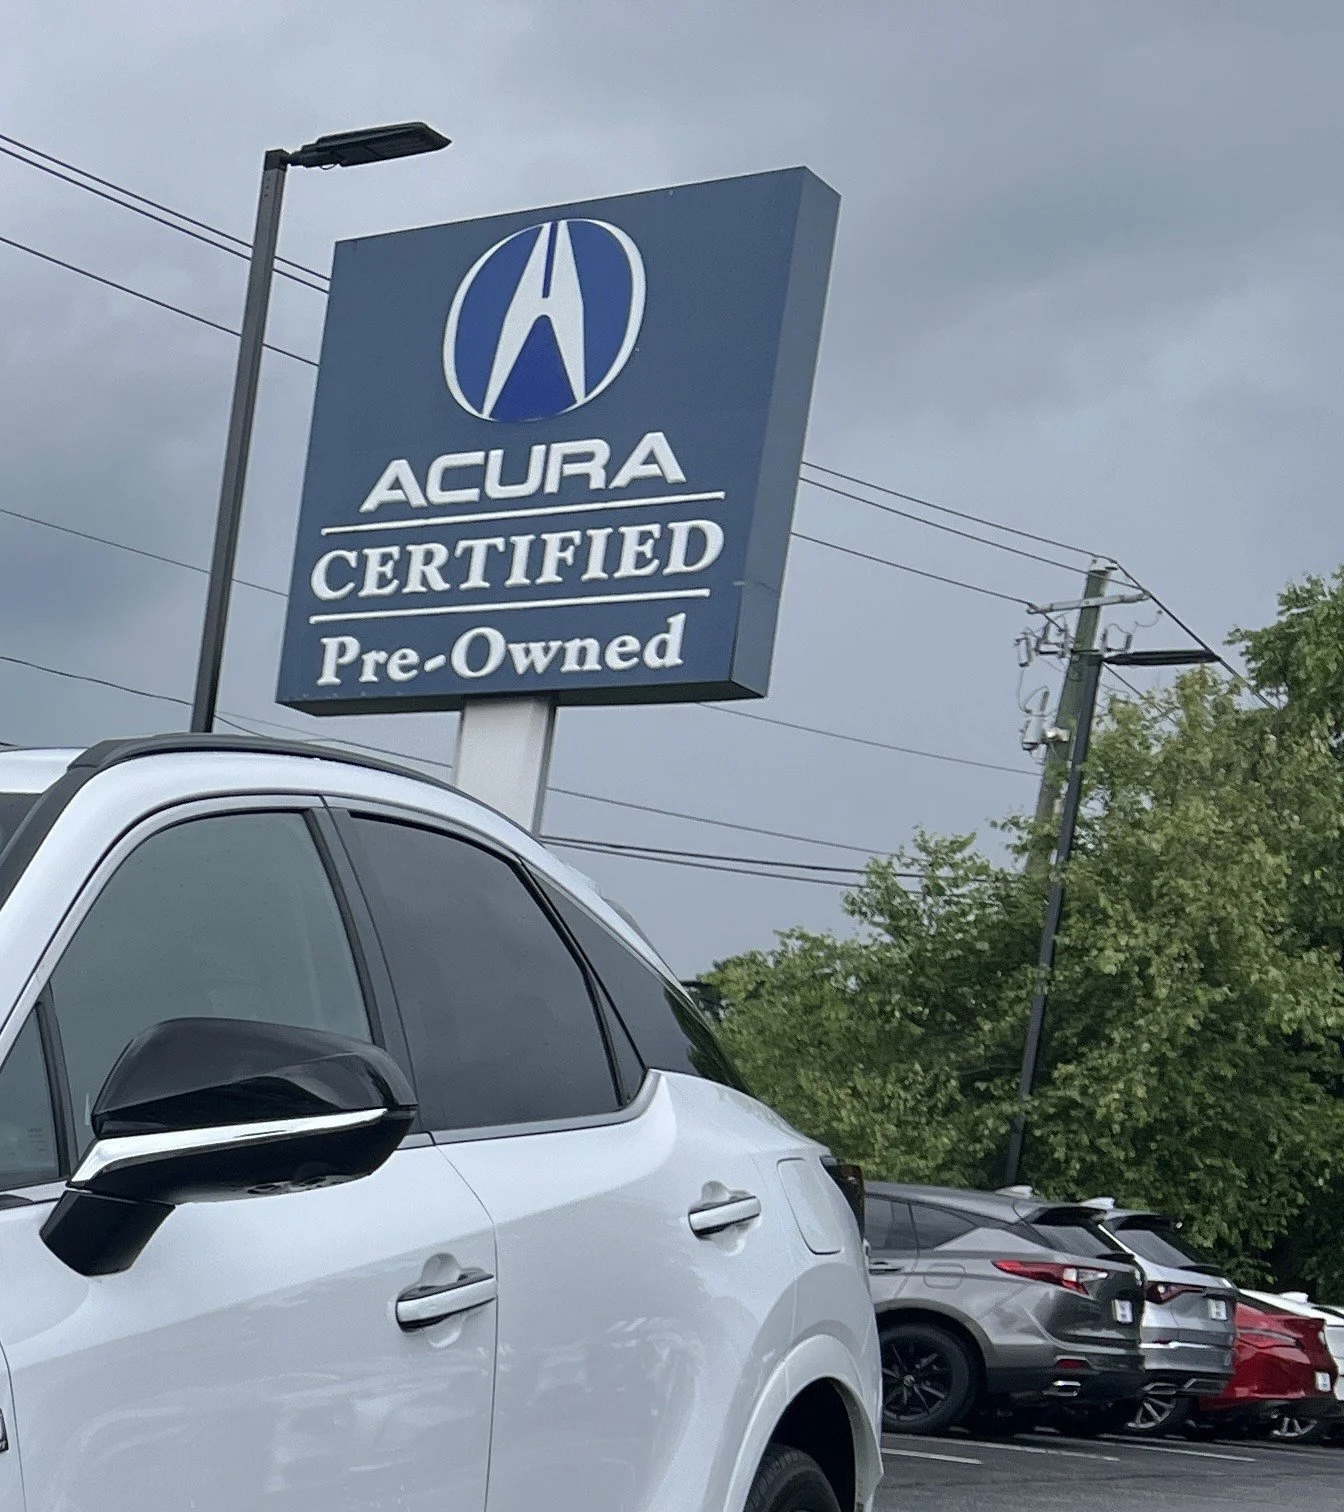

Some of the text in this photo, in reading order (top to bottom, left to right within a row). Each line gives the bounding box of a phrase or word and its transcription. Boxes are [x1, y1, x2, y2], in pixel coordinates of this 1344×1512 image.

[359, 431, 686, 513] ACURA
[310, 519, 725, 600] CERTIFIED
[316, 612, 687, 686] Pre-Owned
